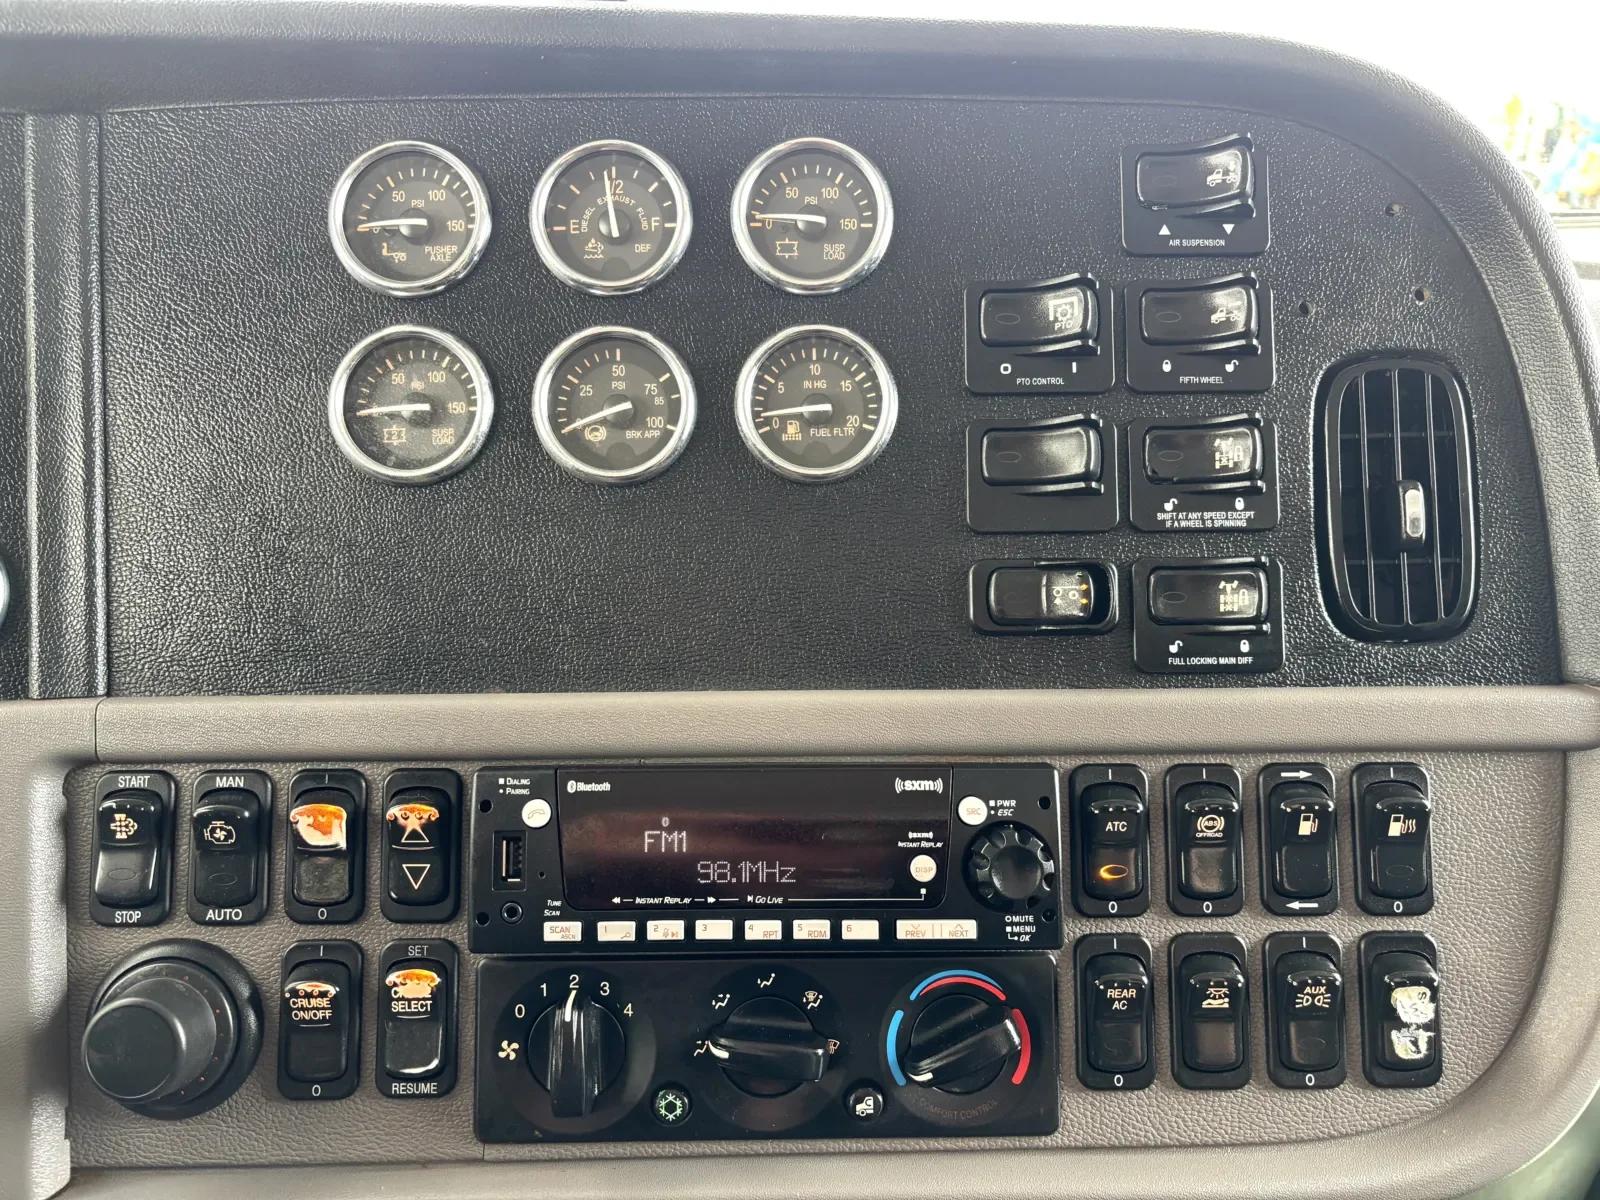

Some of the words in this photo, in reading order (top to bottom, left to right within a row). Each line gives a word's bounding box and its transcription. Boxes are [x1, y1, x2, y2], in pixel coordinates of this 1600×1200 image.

[392, 191, 405, 202] 50
[428, 190, 446, 200] 100
[786, 187, 798, 198] 50
[821, 187, 838, 198] 100
[804, 196, 818, 204] PSI
[447, 220, 464, 232] 150
[570, 220, 580, 234] E
[652, 218, 660, 232] F
[766, 219, 772, 230] 0
[840, 218, 858, 230] 150
[425, 246, 458, 254] PUSHER
[634, 244, 652, 252] DEF
[824, 244, 845, 252] SUSP
[824, 252, 844, 260] LOAD
[612, 365, 625, 376] 50
[810, 364, 820, 376] 10
[392, 373, 404, 384] 50
[428, 372, 446, 382] 100
[1016, 378, 1030, 386] PTO
[580, 385, 592, 396] 25
[612, 382, 626, 390] PSI
[644, 384, 658, 395] 75
[778, 382, 784, 394] 5
[840, 380, 852, 392] 15
[448, 402, 466, 413] 150
[646, 416, 664, 428] 100
[772, 417, 780, 428] 0
[846, 416, 860, 428] 20
[644, 430, 660, 438] APP
[810, 428, 832, 437] FUEL
[834, 428, 854, 436] FLTR
[118, 776, 150, 788] START
[216, 776, 244, 788] MAN
[576, 782, 611, 792] Bluetooth
[1106, 822, 1128, 832] ATC
[644, 830, 687, 852] FM1
[698, 860, 796, 883] 98.1MHz
[115, 911, 142, 923] STOP
[206, 909, 242, 921] AUTO
[408, 946, 429, 956] SET
[569, 974, 580, 988] 2
[540, 983, 547, 997] 1
[600, 982, 610, 996] 3
[1107, 989, 1137, 999] REAR
[290, 998, 331, 1008] CRUISE
[391, 1000, 433, 1012] SELECT
[1112, 1000, 1128, 1010] AC
[292, 1010, 332, 1020] ON/OFF
[624, 1003, 634, 1017] 4
[392, 1083, 438, 1094] RESUME
